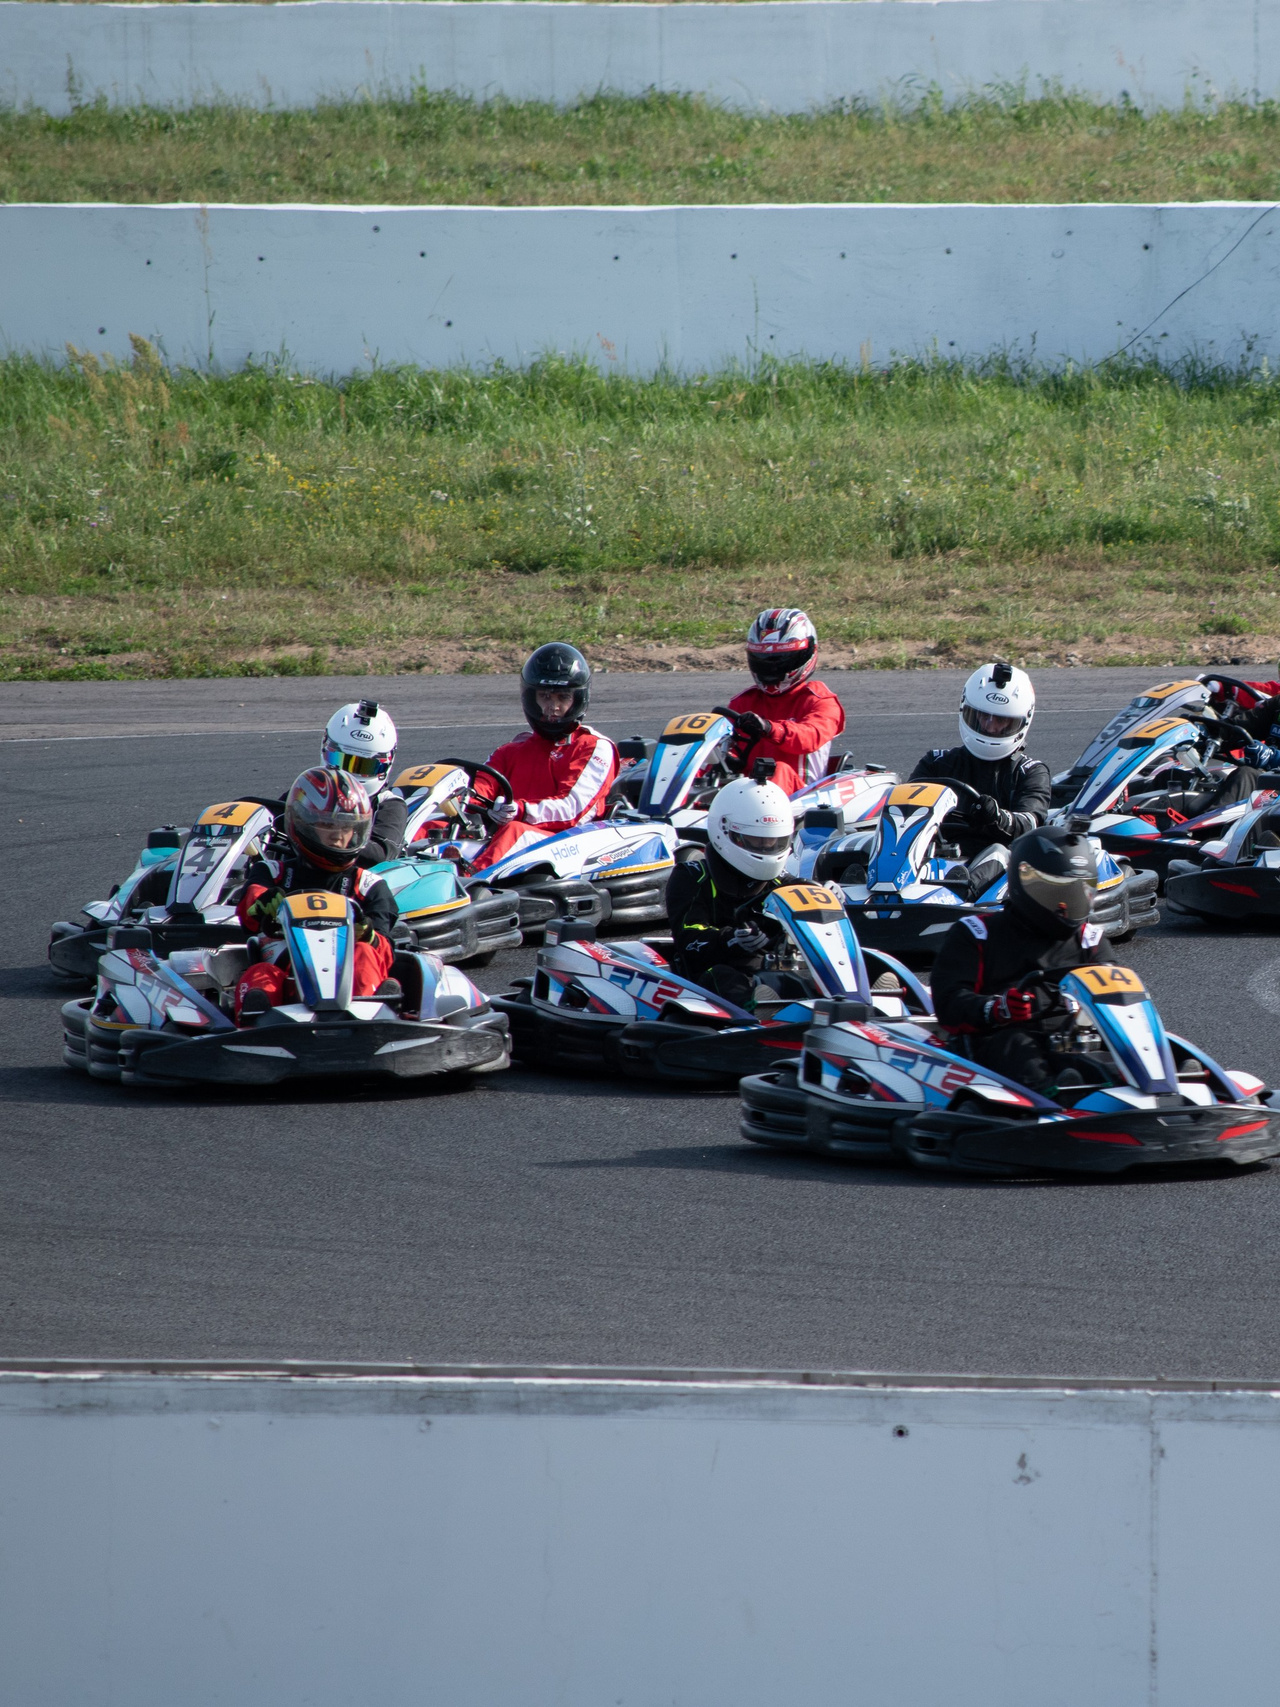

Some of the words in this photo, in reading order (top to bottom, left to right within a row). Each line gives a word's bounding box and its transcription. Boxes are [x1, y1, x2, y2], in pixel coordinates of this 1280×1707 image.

[988, 693, 1007, 703] Arai
[675, 715, 711, 729] 16
[1100, 718, 1134, 740] 5
[1133, 719, 1177, 734] 17
[409, 766, 436, 780] 9
[908, 784, 928, 800] 7
[213, 803, 240, 819] 4
[184, 848, 216, 872] 4
[550, 843, 579, 861] Haier
[306, 894, 328, 911] 6
[788, 887, 832, 905] 15
[1086, 968, 1131, 986] 14
